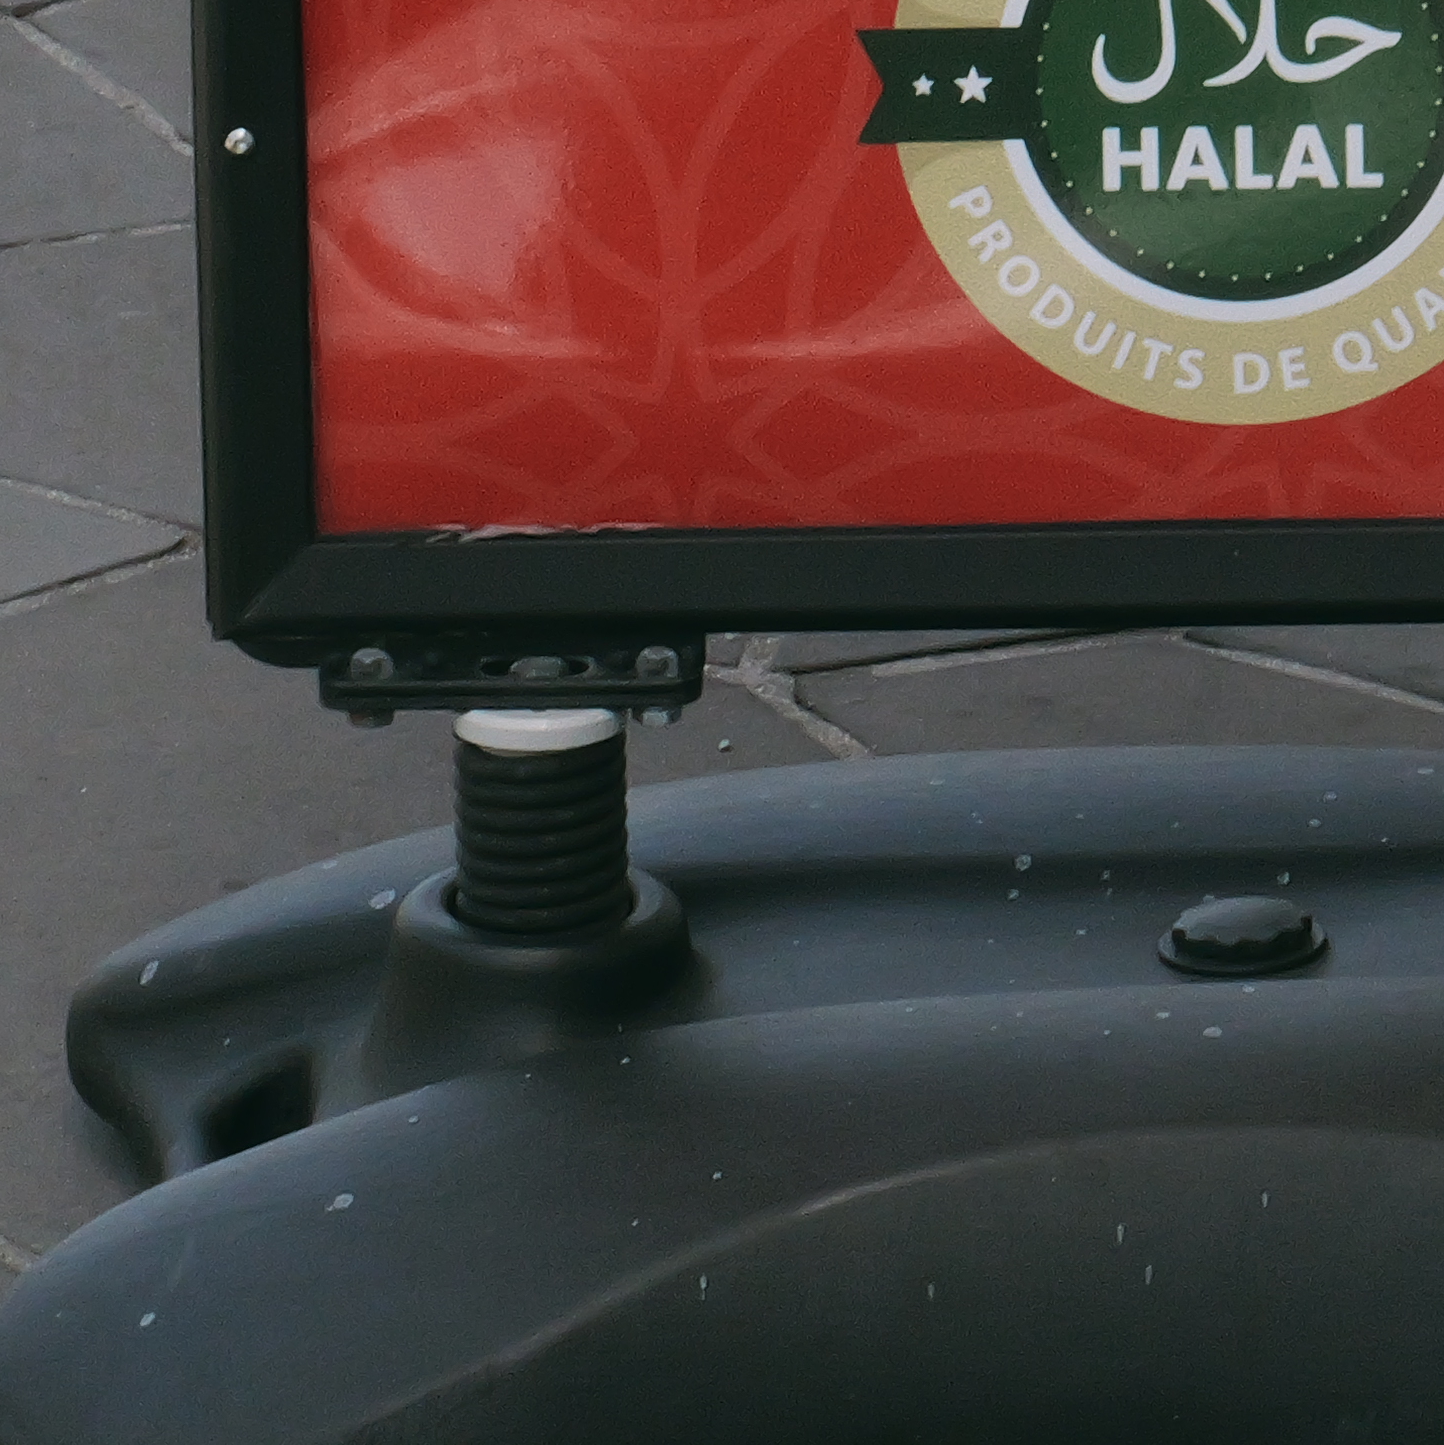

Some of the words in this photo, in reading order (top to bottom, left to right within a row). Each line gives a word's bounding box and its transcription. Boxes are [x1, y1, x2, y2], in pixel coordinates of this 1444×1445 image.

[1101, 122, 1385, 192] HALAL
[948, 184, 1207, 391] PRODUITS
[1234, 347, 1310, 395] DE
